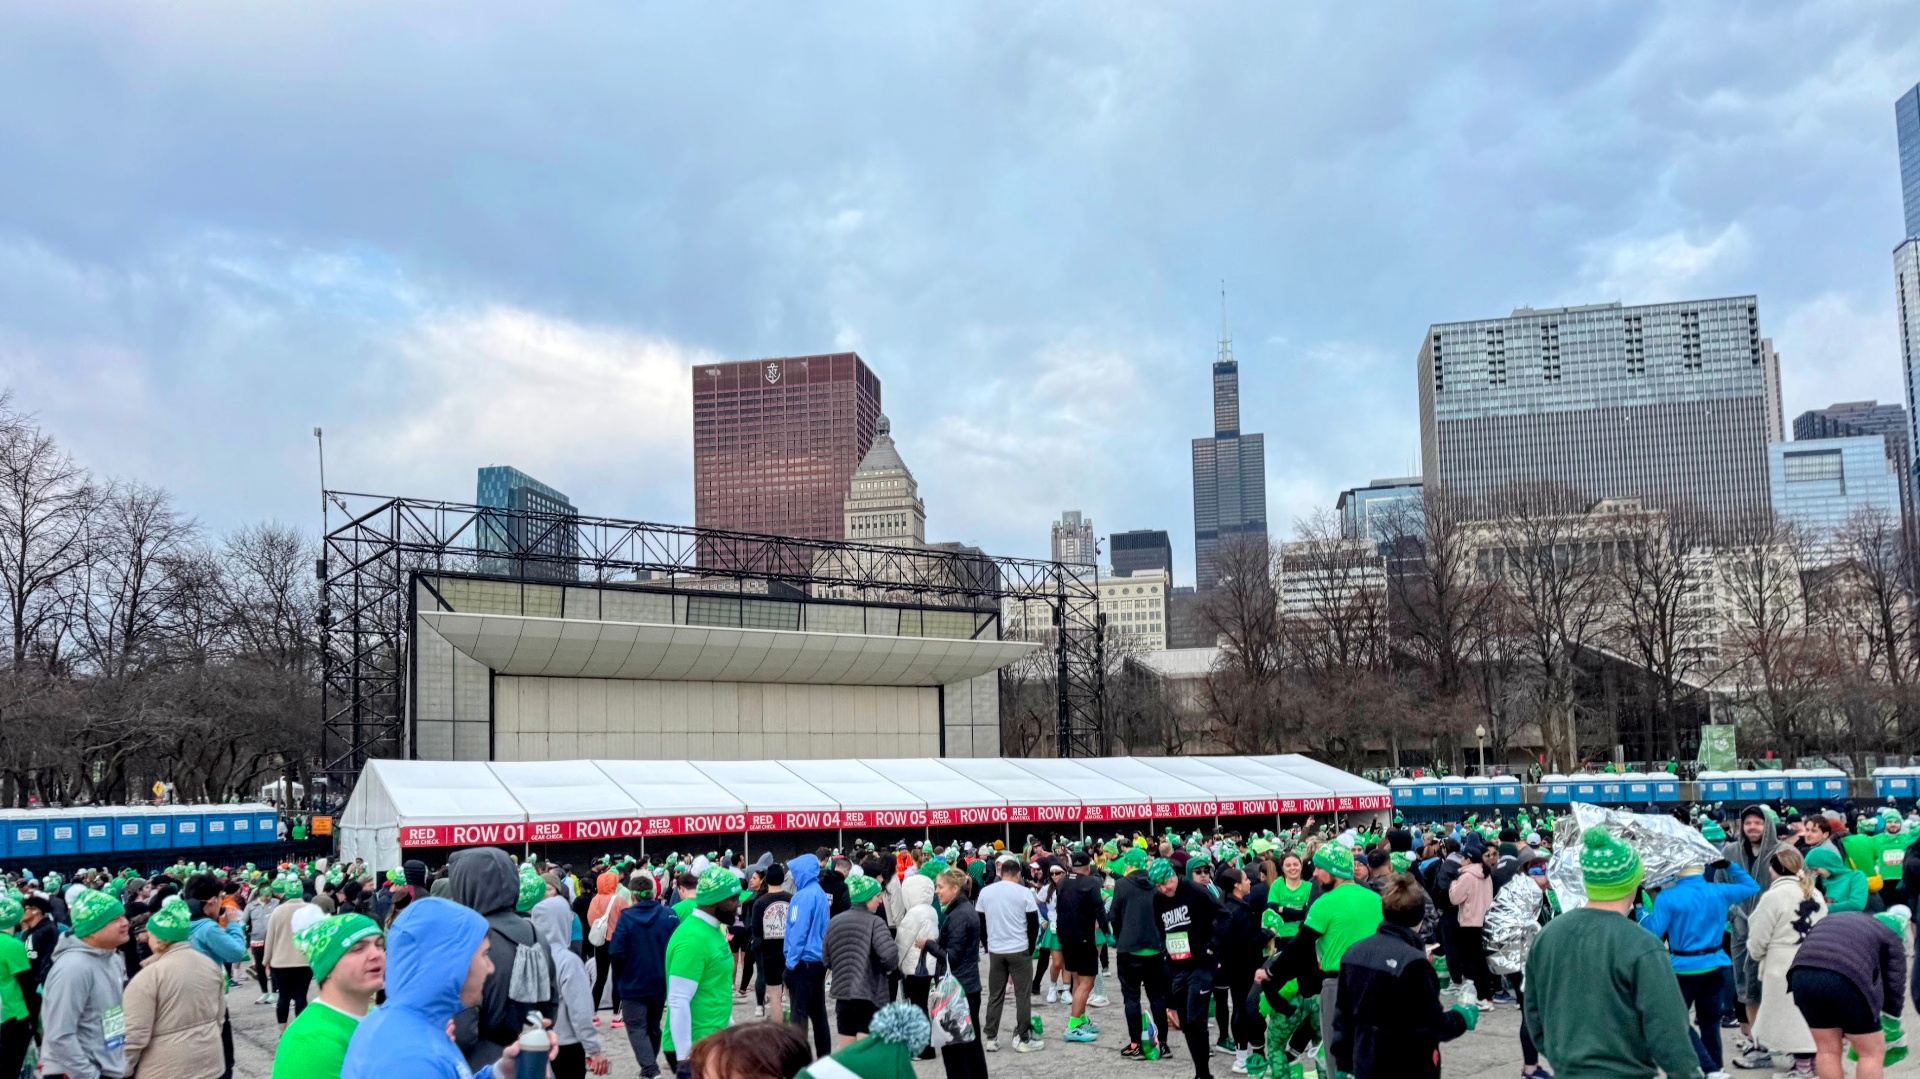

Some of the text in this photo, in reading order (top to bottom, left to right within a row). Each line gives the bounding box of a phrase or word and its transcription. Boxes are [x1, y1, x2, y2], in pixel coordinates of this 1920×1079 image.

[1243, 801, 1265, 813] ROW
[1268, 800, 1278, 812] 10
[1283, 800, 1295, 808] RED
[1304, 799, 1324, 811] ROW
[1327, 799, 1334, 810] 11
[1340, 798, 1352, 806] RED
[1360, 796, 1391, 808] ROW 12
[933, 811, 949, 819] RED
[960, 807, 1007, 822] ROW 06
[1013, 808, 1028, 816] RED
[1038, 806, 1081, 820] ROW 07
[1087, 807, 1101, 815] RED
[1110, 805, 1152, 818] ROW 08
[1178, 802, 1217, 816] ROW 09
[753, 815, 773, 824] RED
[787, 812, 840, 828] ROW 04
[846, 812, 864, 821] RED
[876, 811, 927, 825] ROW 05
[536, 824, 559, 834] RED
[576, 820, 642, 837] ROW 02
[649, 819, 670, 828] RED
[685, 815, 745, 832] ROW 03
[410, 829, 436, 839] RED
[454, 825, 525, 843] ROW 01
